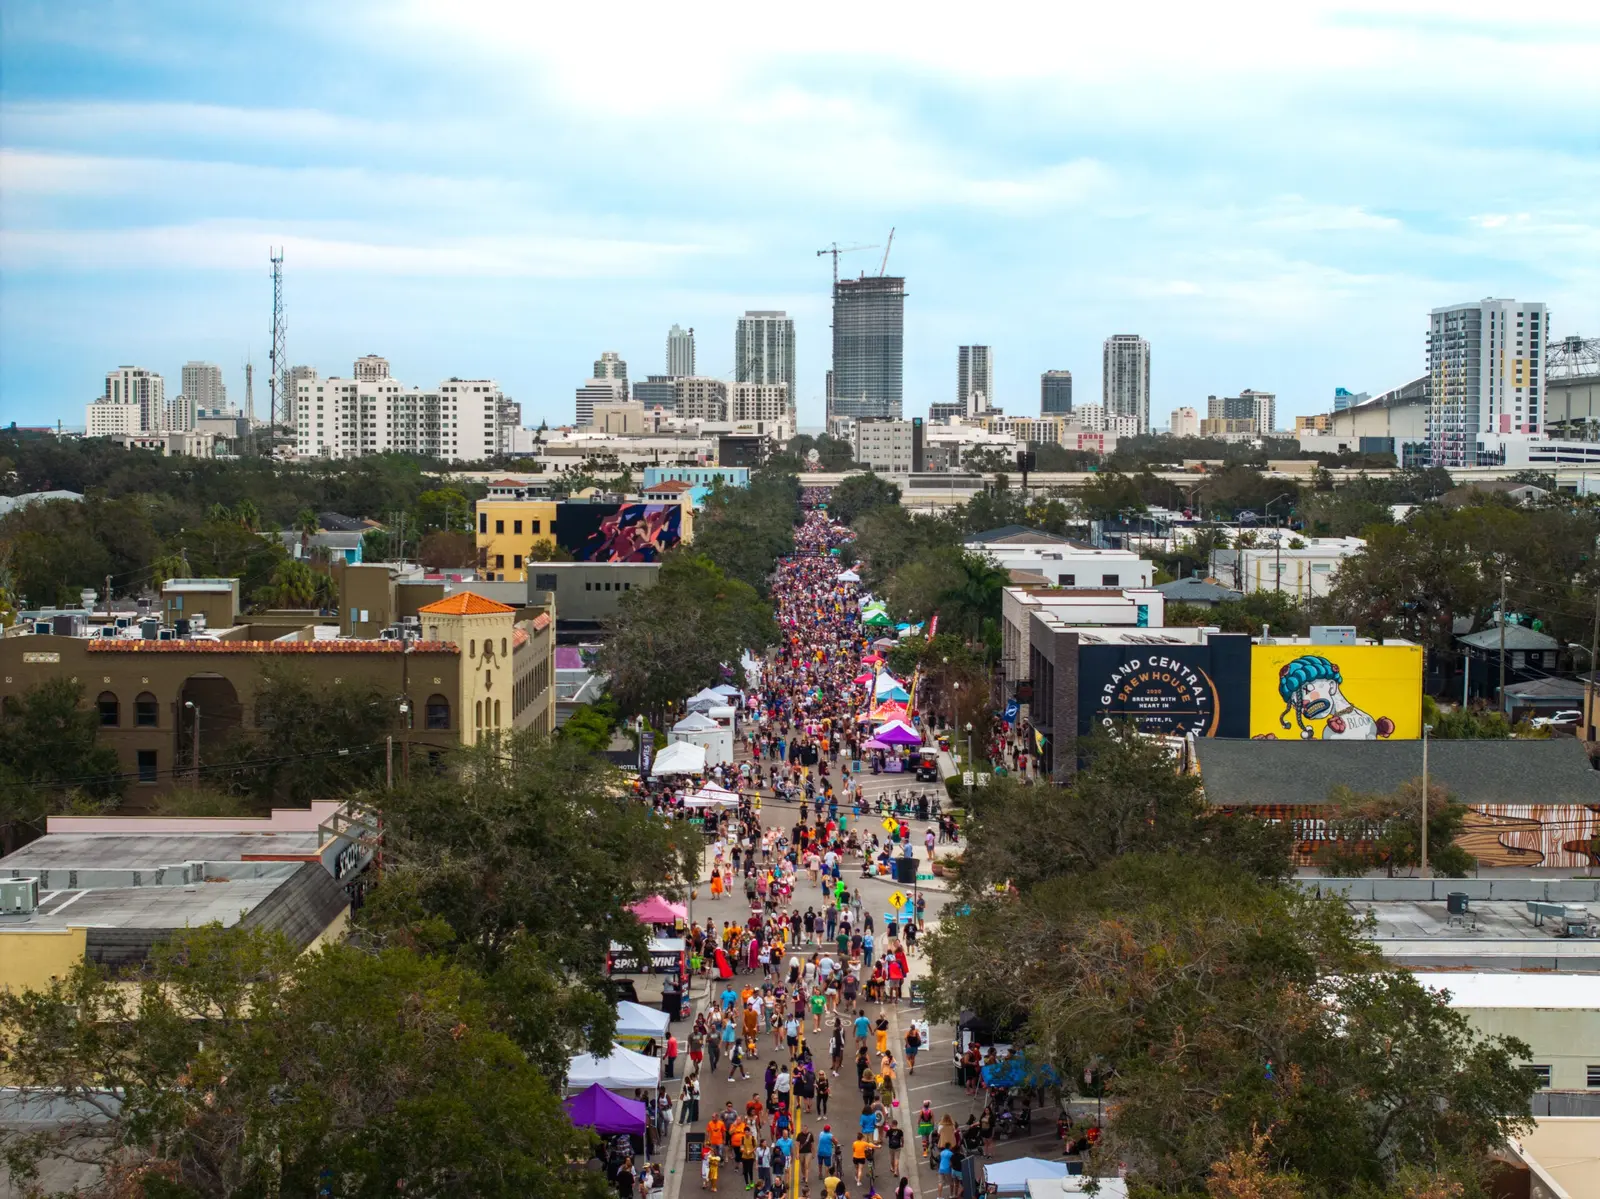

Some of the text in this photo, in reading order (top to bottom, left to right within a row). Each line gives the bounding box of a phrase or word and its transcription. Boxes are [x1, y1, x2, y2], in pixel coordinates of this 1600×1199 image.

[1101, 656, 1206, 706] GRAND CENTRAL
[1118, 671, 1191, 703] BREWHOUSE
[651, 956, 676, 967] WIN!
